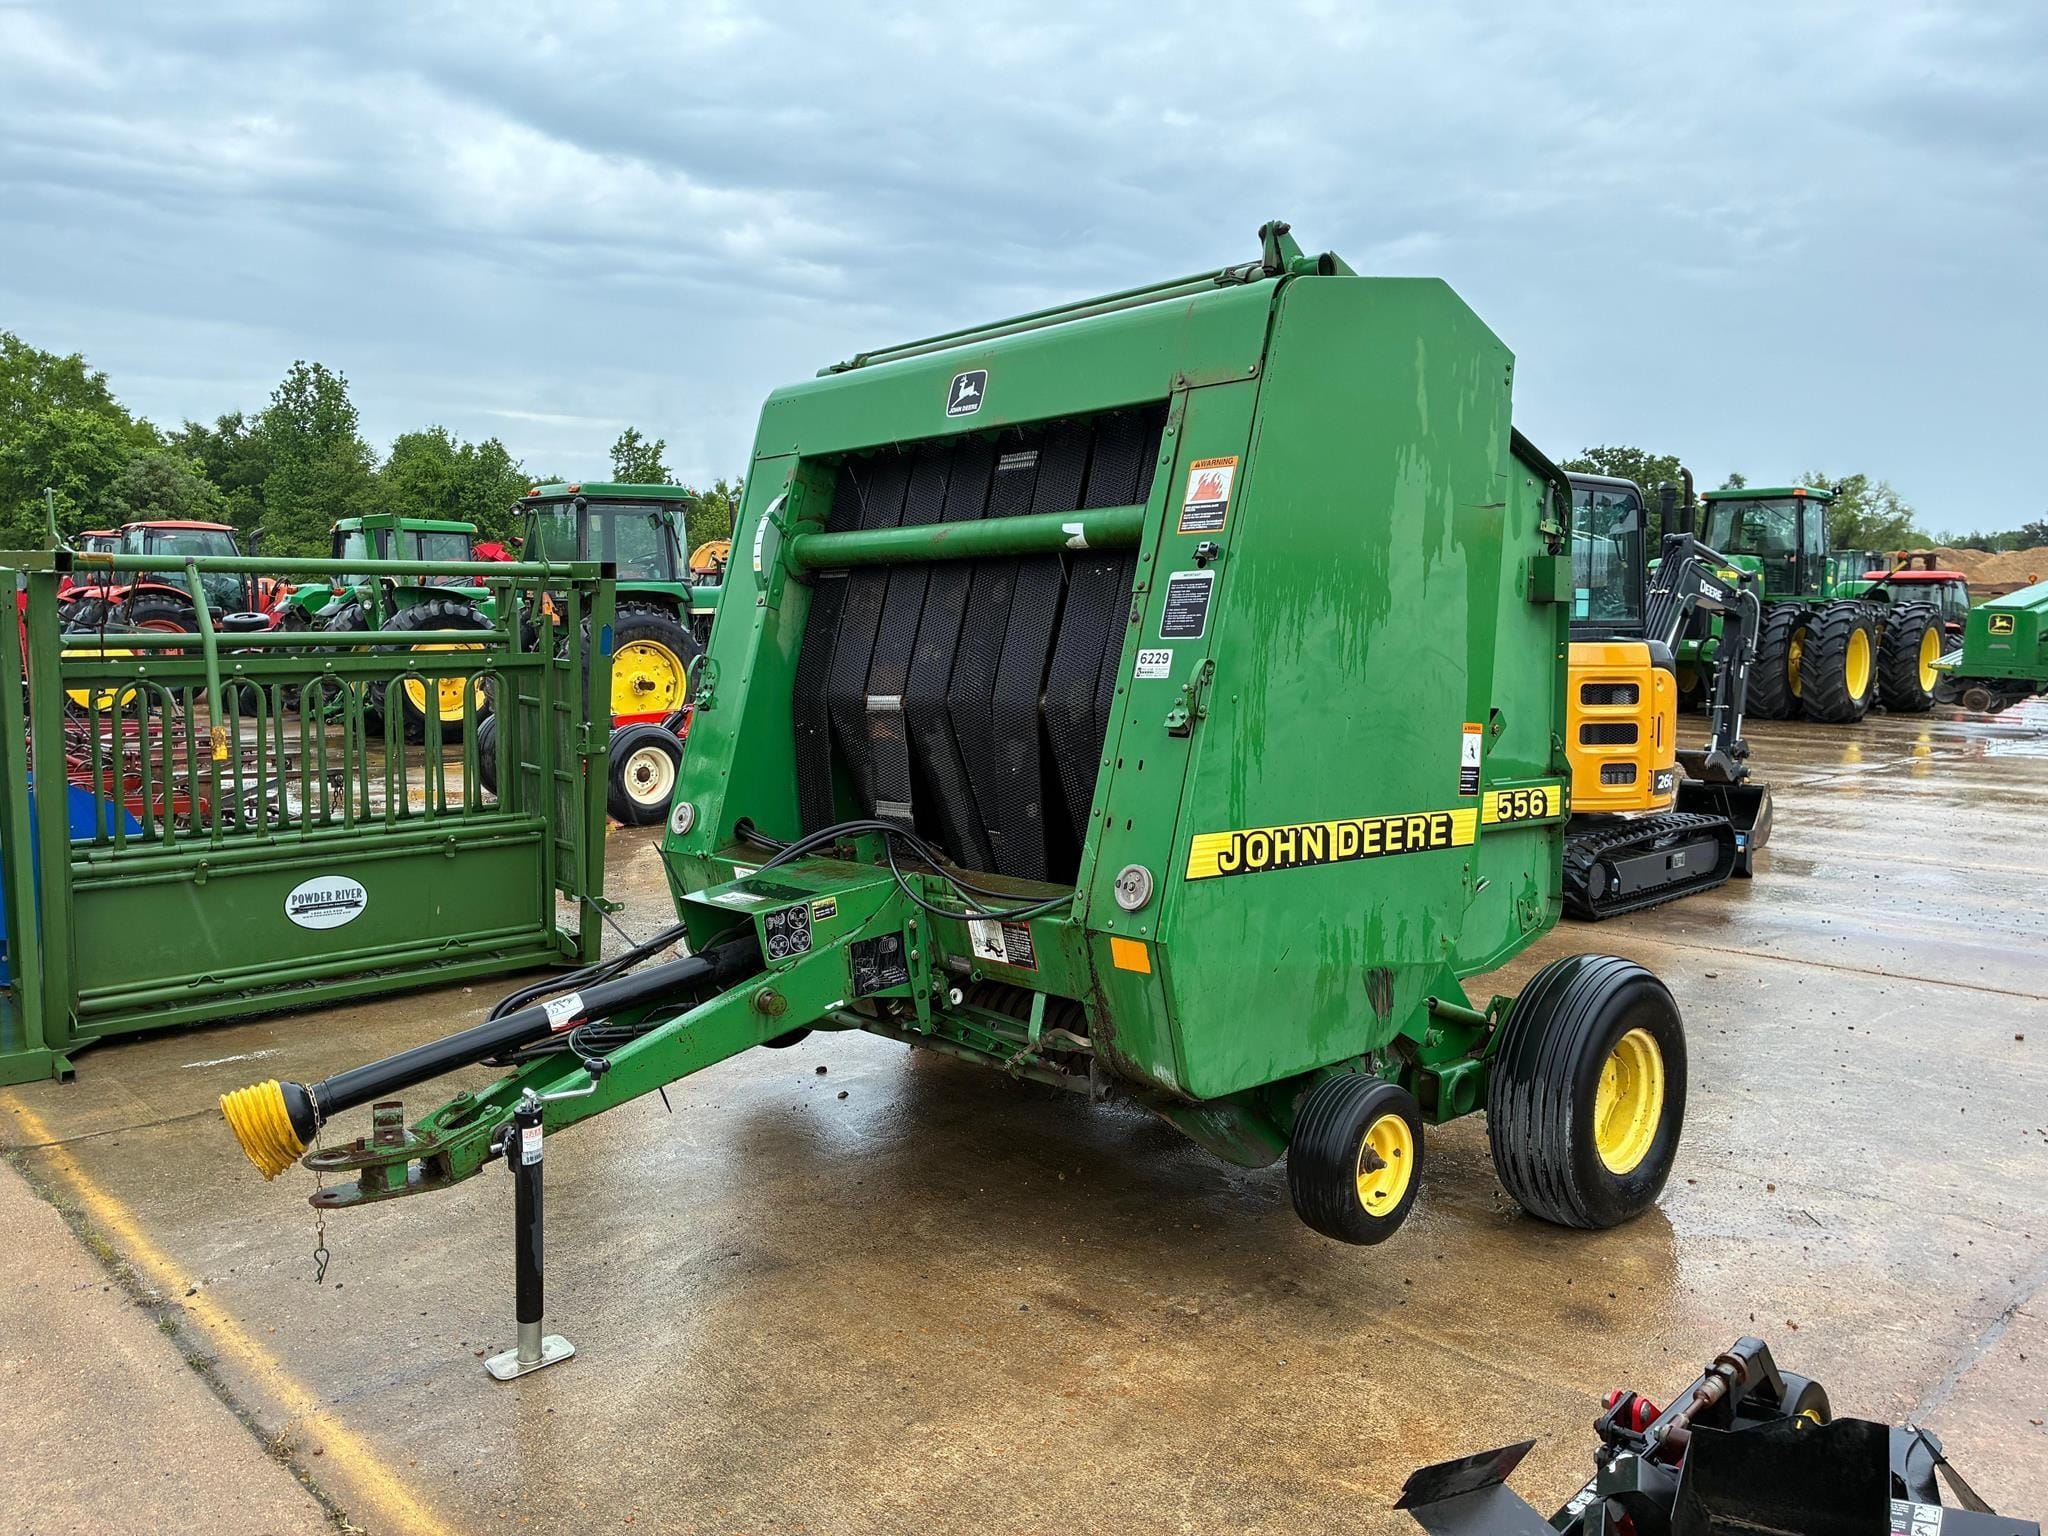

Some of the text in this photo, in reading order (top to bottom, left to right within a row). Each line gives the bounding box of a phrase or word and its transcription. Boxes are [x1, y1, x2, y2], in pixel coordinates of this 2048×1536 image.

[1200, 457, 1234, 467] WARNING
[1700, 578, 1723, 602] DEERE
[1140, 652, 1170, 665] 6229
[1497, 789, 1547, 820] 556
[1218, 813, 1451, 872] JOHN DEERE
[291, 890, 333, 906] POWDER
[335, 887, 362, 901] RIVER
